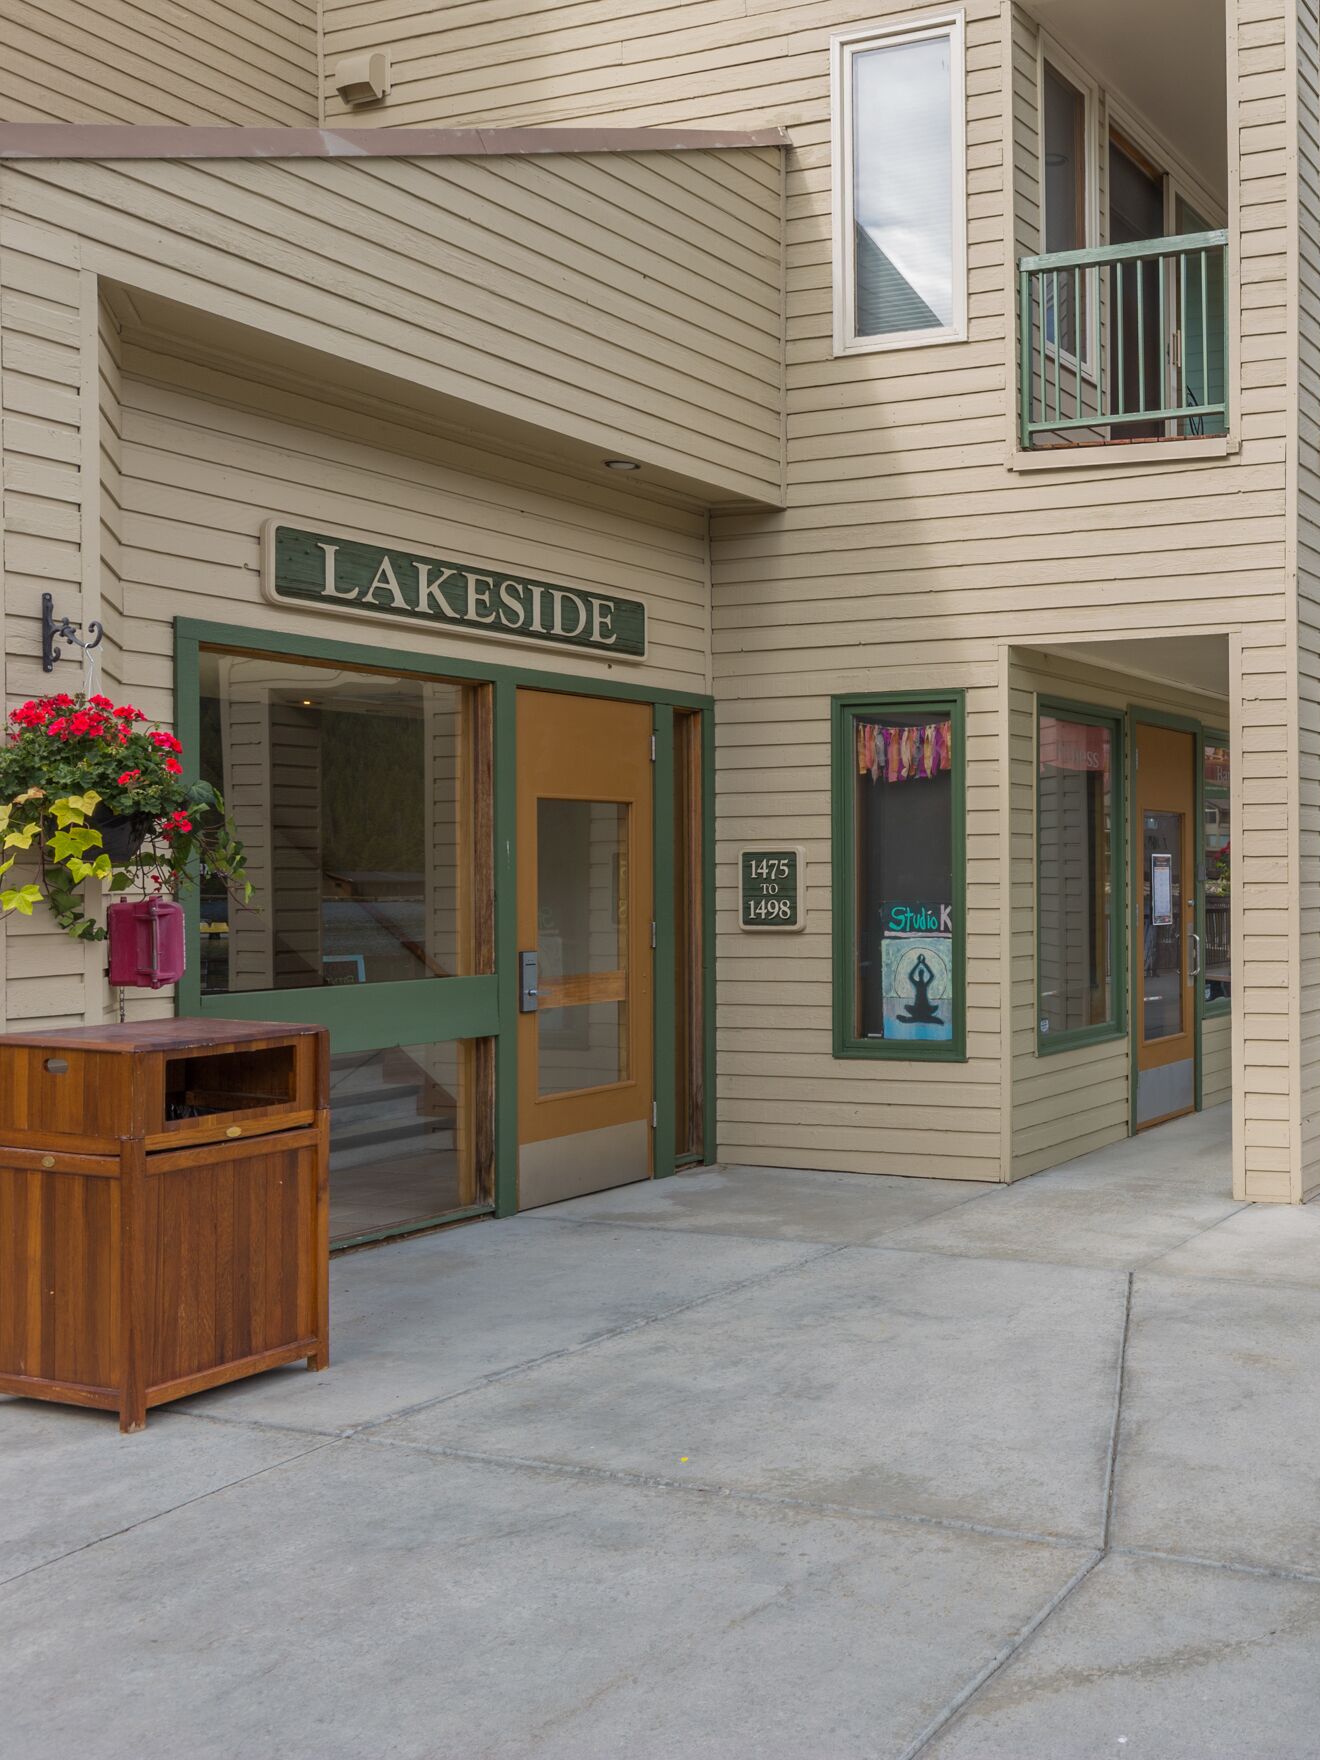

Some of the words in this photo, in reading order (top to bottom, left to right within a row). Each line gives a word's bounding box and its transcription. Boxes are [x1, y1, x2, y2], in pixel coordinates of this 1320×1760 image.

[317, 543, 617, 644] LAKESIDE
[749, 858, 789, 879] 1475
[760, 883, 778, 895] TO
[748, 898, 791, 919] 1498
[889, 906, 938, 931] Studio
[940, 904, 952, 931] K
